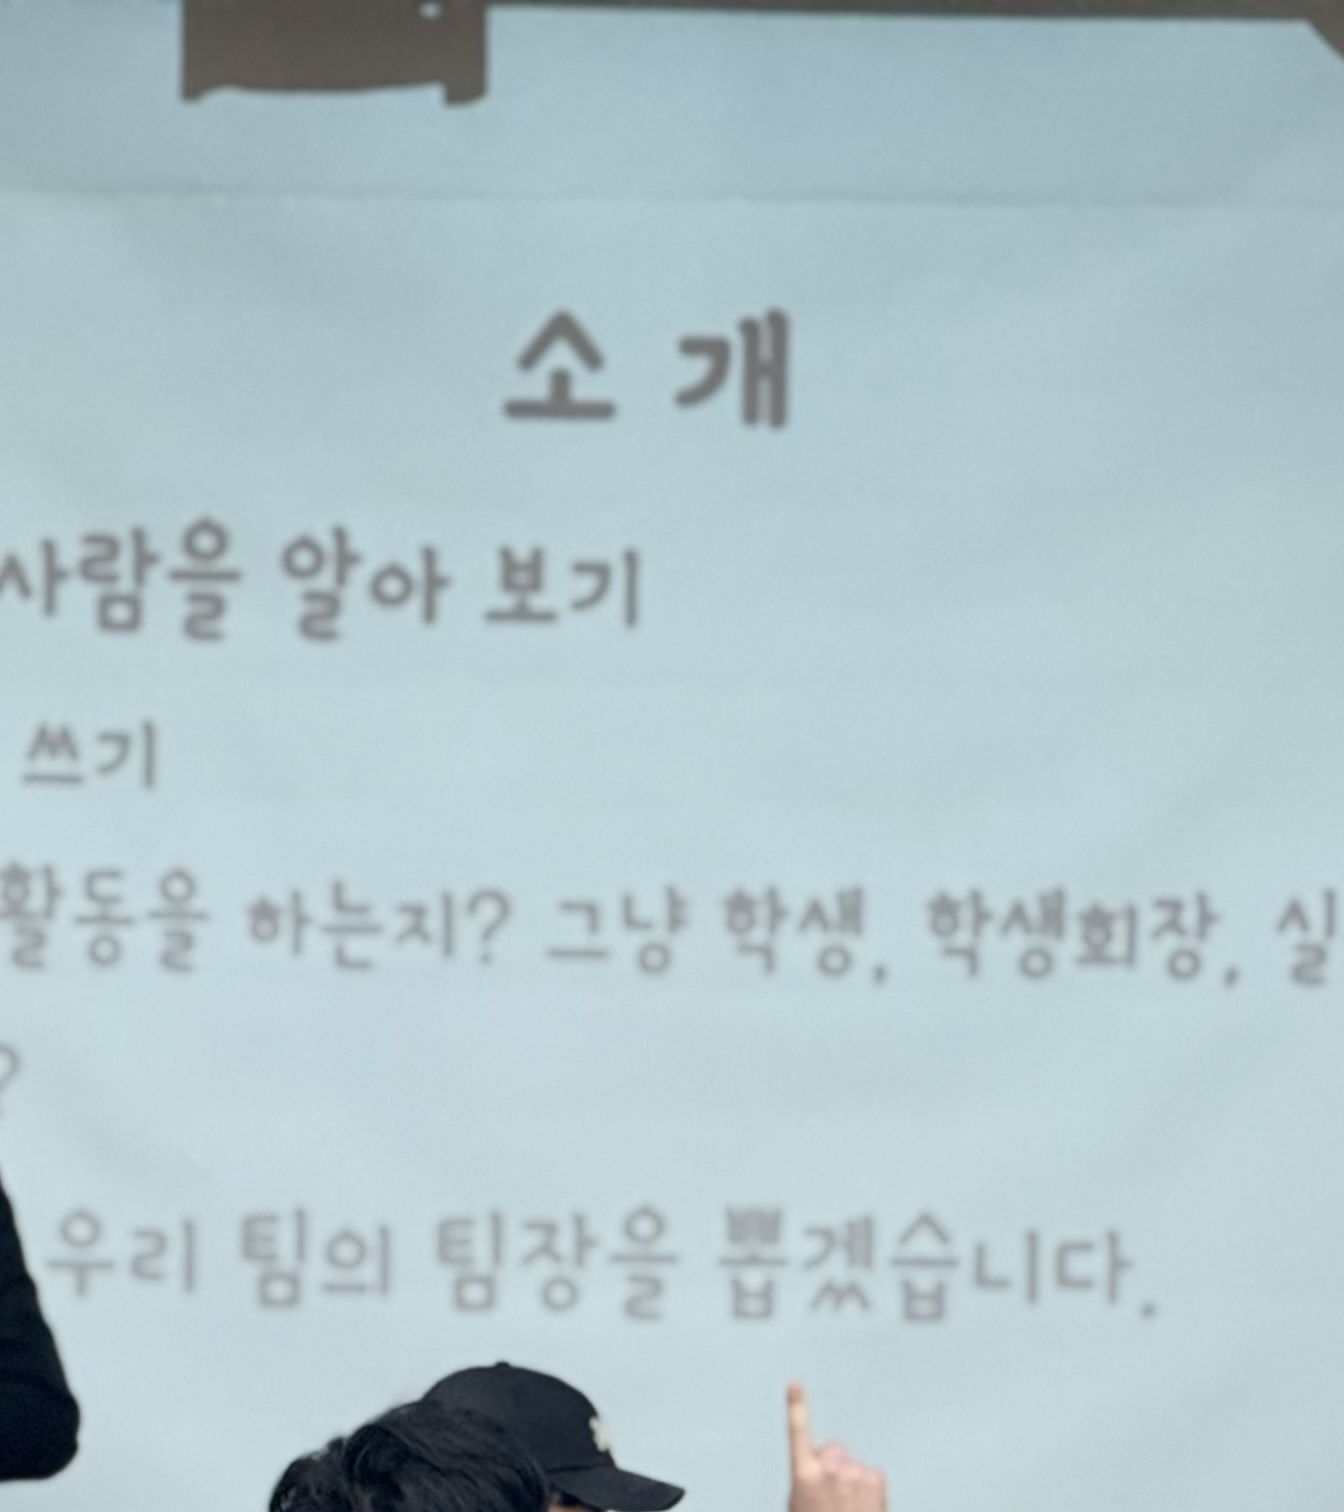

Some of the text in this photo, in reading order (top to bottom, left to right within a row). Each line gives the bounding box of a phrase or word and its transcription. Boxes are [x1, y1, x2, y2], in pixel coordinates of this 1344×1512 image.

[278, 522, 453, 645] 알아
[483, 542, 642, 631] 보기
[21, 718, 159, 791] 쓰기
[245, 877, 514, 974] 하는지?
[546, 882, 690, 979] 그냥
[721, 884, 889, 988] 학생,
[925, 885, 1241, 989] 학생회장,
[47, 1210, 198, 1300] 우리
[237, 1206, 394, 1313] 팀의
[432, 1202, 681, 1324] 팀장을
[717, 1205, 1159, 1327] 뽑겠습니다.
